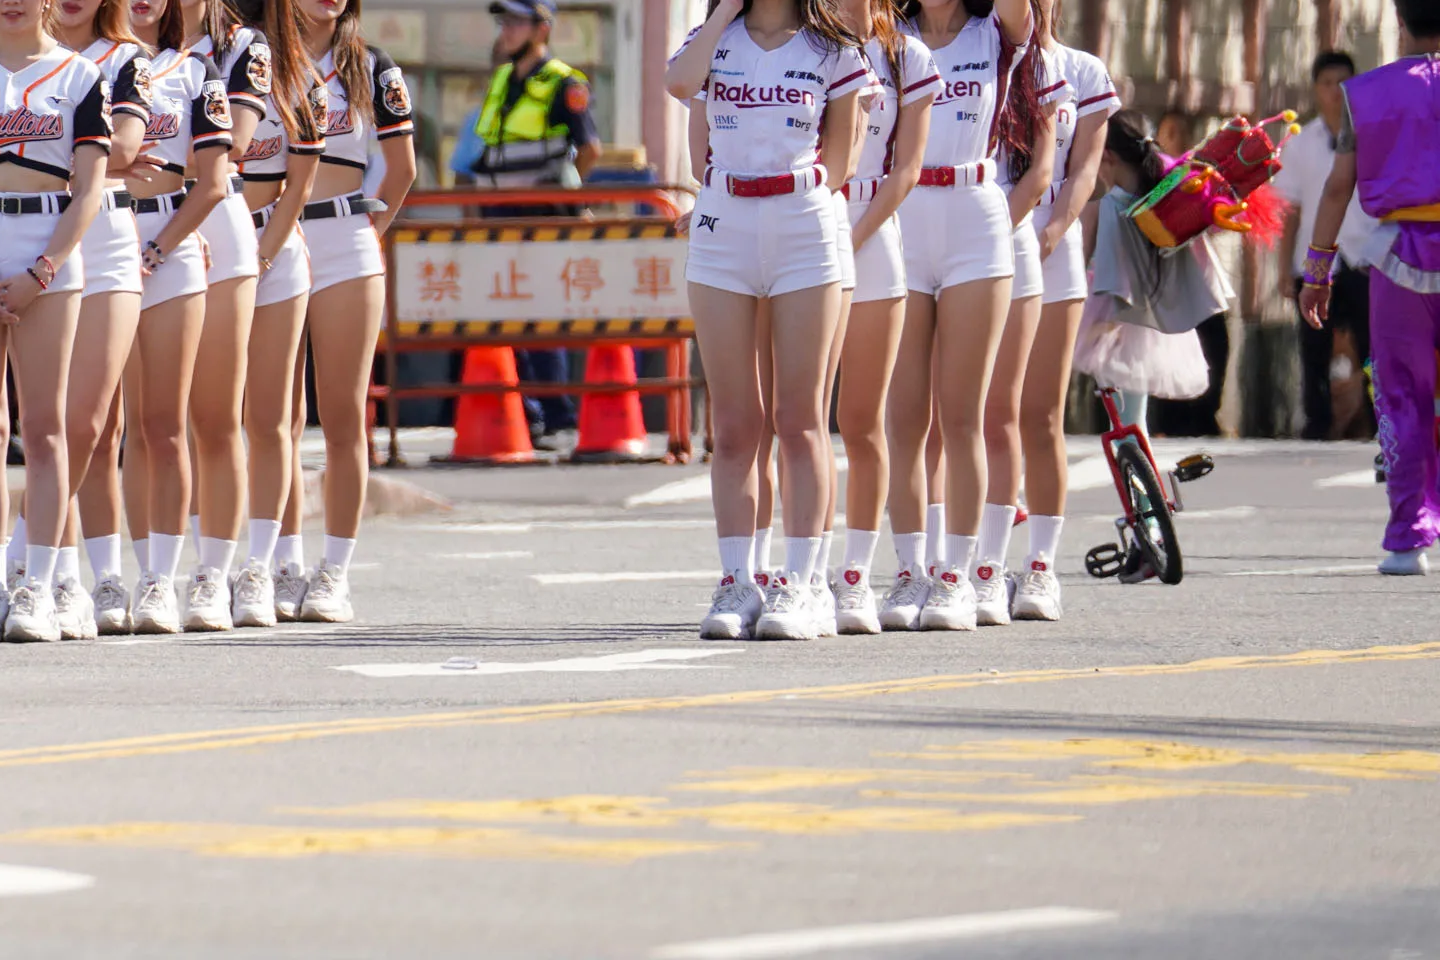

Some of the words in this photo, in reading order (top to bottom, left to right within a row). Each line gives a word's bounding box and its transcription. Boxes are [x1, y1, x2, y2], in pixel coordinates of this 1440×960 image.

[713, 82, 815, 107] Rakuten
[713, 114, 739, 125] HMC
[867, 124, 881, 136] rg
[418, 256, 678, 303] 禁止停車
